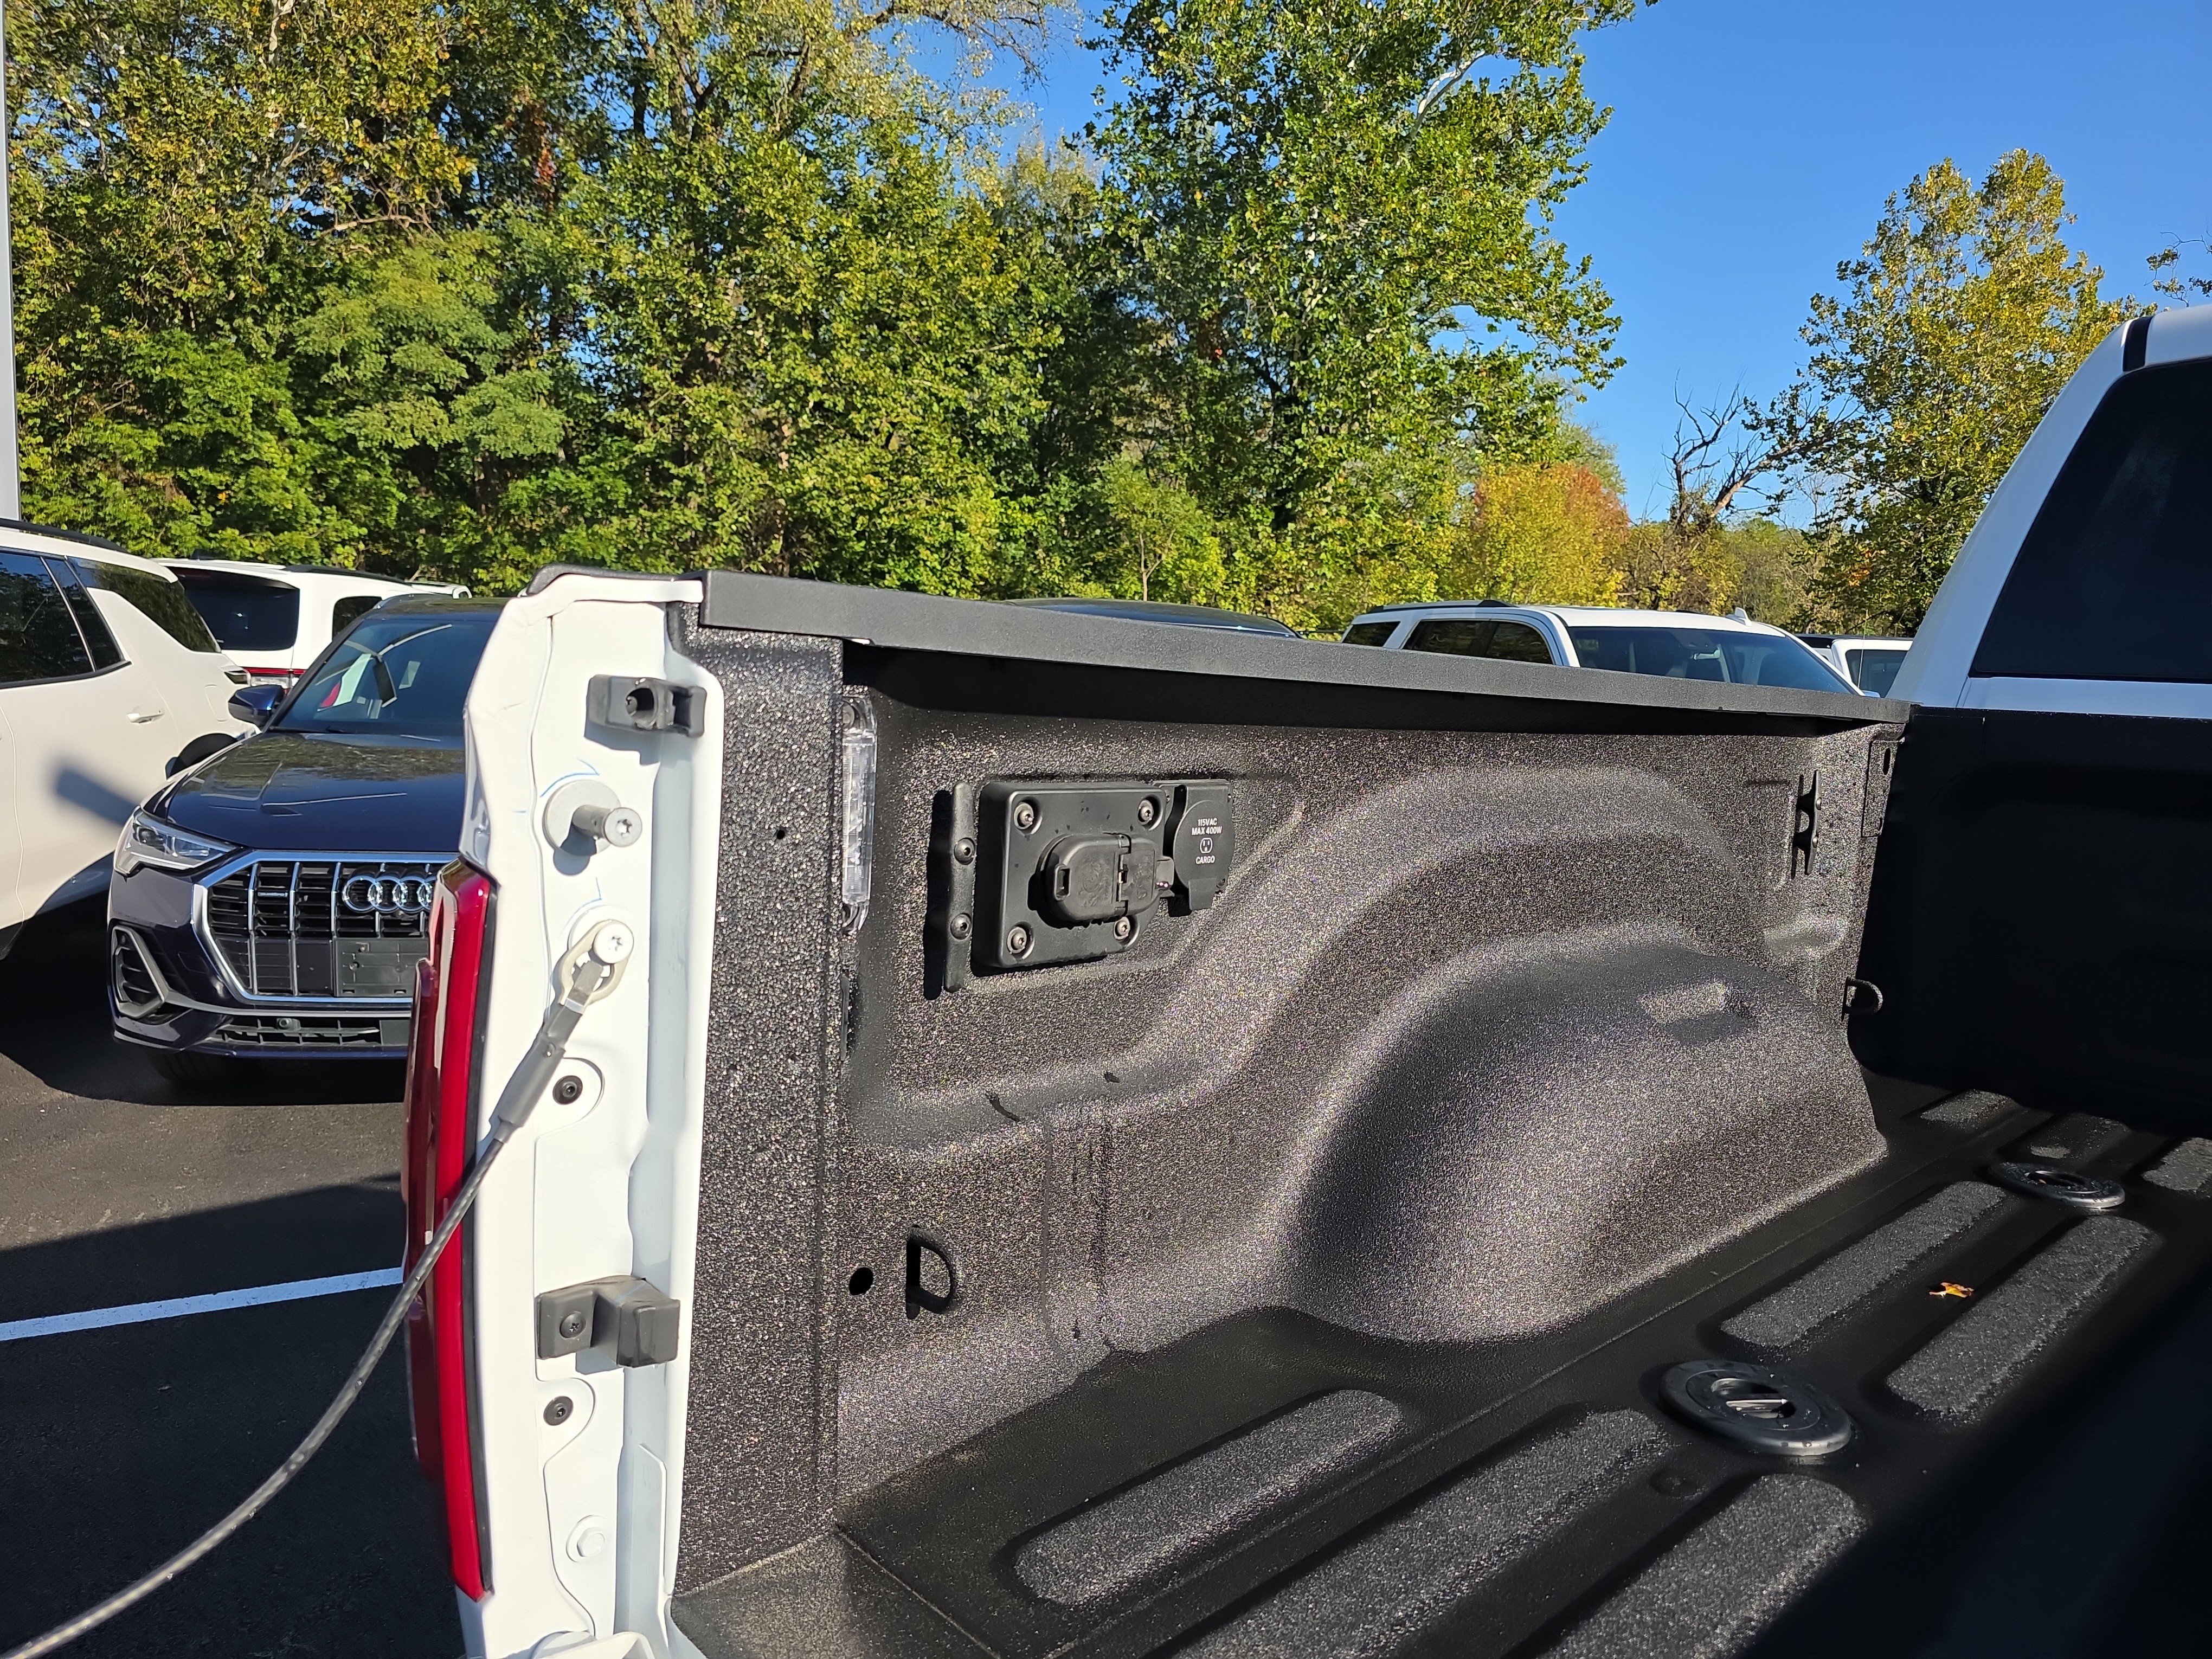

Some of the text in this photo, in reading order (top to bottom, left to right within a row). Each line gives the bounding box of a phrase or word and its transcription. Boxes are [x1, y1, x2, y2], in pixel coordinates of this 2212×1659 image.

[1198, 818, 1217, 826] 115VAC
[1192, 826, 1222, 835] MAX 400W
[1195, 856, 1215, 864] CARGO
